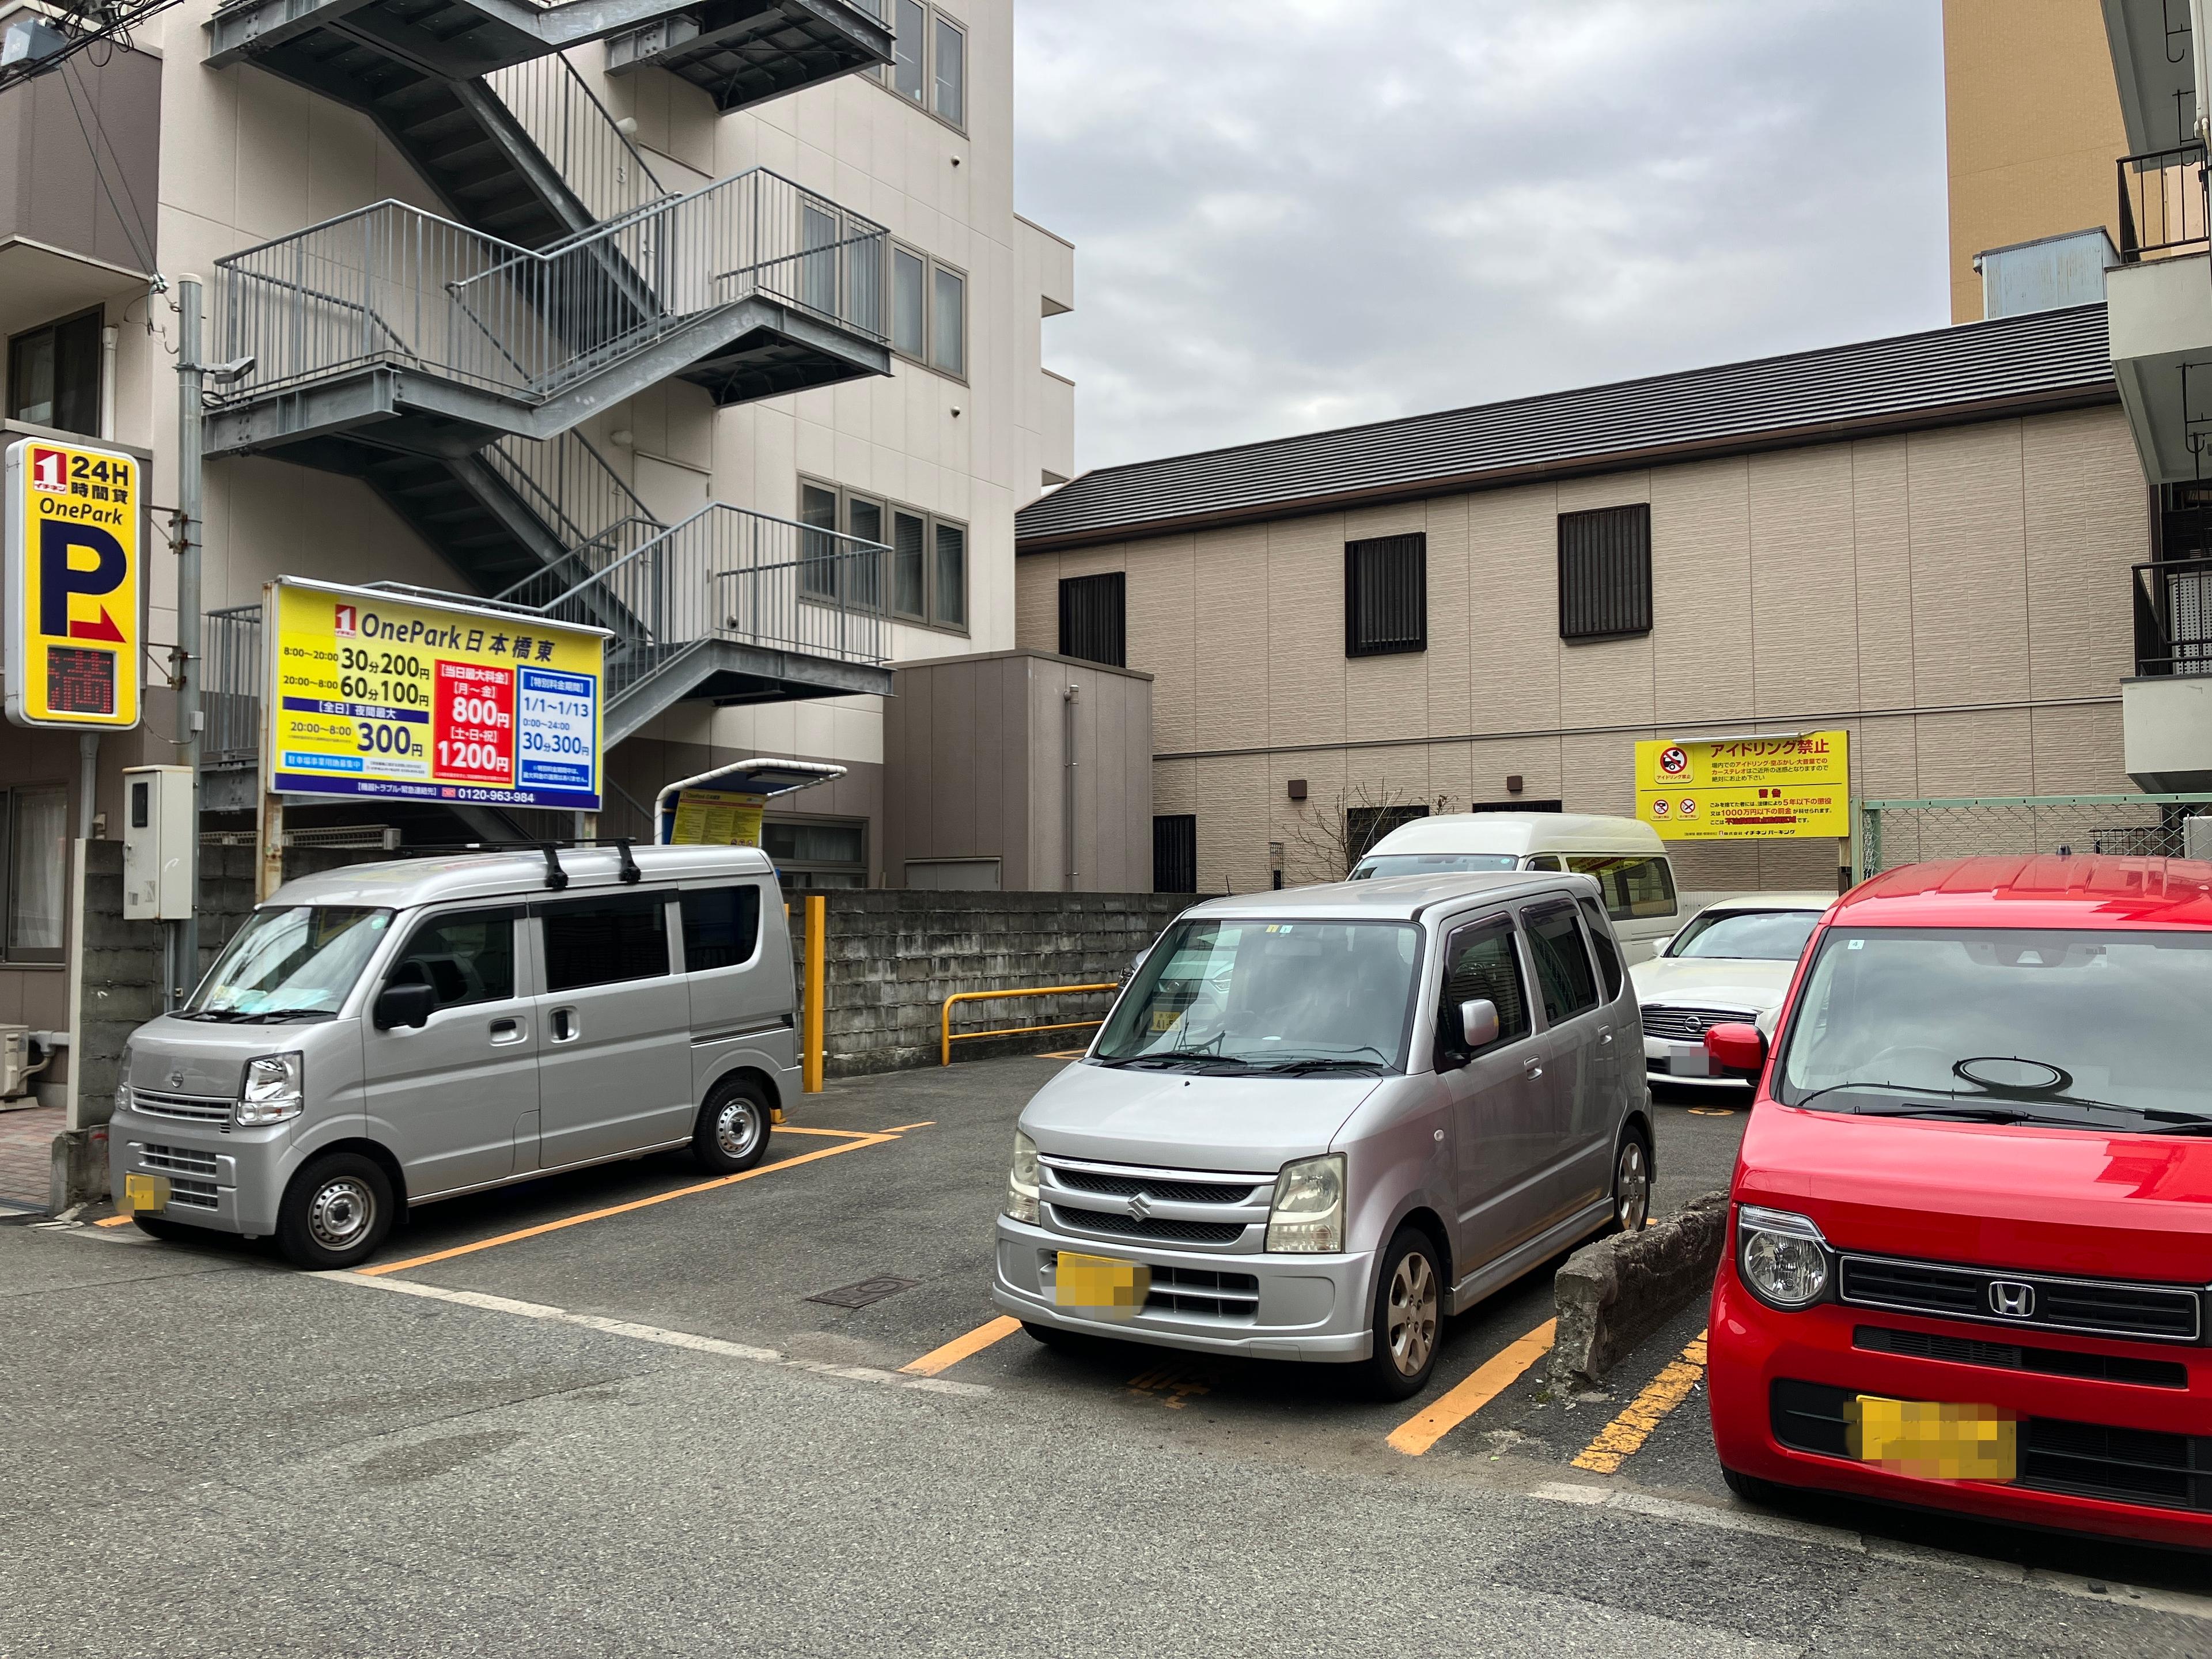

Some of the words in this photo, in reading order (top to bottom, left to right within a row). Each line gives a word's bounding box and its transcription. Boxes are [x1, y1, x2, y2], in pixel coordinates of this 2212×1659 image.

[71, 456, 128, 486] 24H
[35, 483, 66, 491] イチネン
[71, 482, 128, 505] 時間貸
[40, 498, 123, 525] OnePark
[40, 518, 127, 637] P
[452, 696, 510, 729] 800円
[357, 722, 423, 757] 300円
[1710, 738, 1830, 758] アイドリング禁止
[438, 741, 509, 772] 1200円
[1711, 765, 1828, 775] カーステレオはご近所の迷惑となりますので
[458, 789, 535, 803] 0120-963-984
